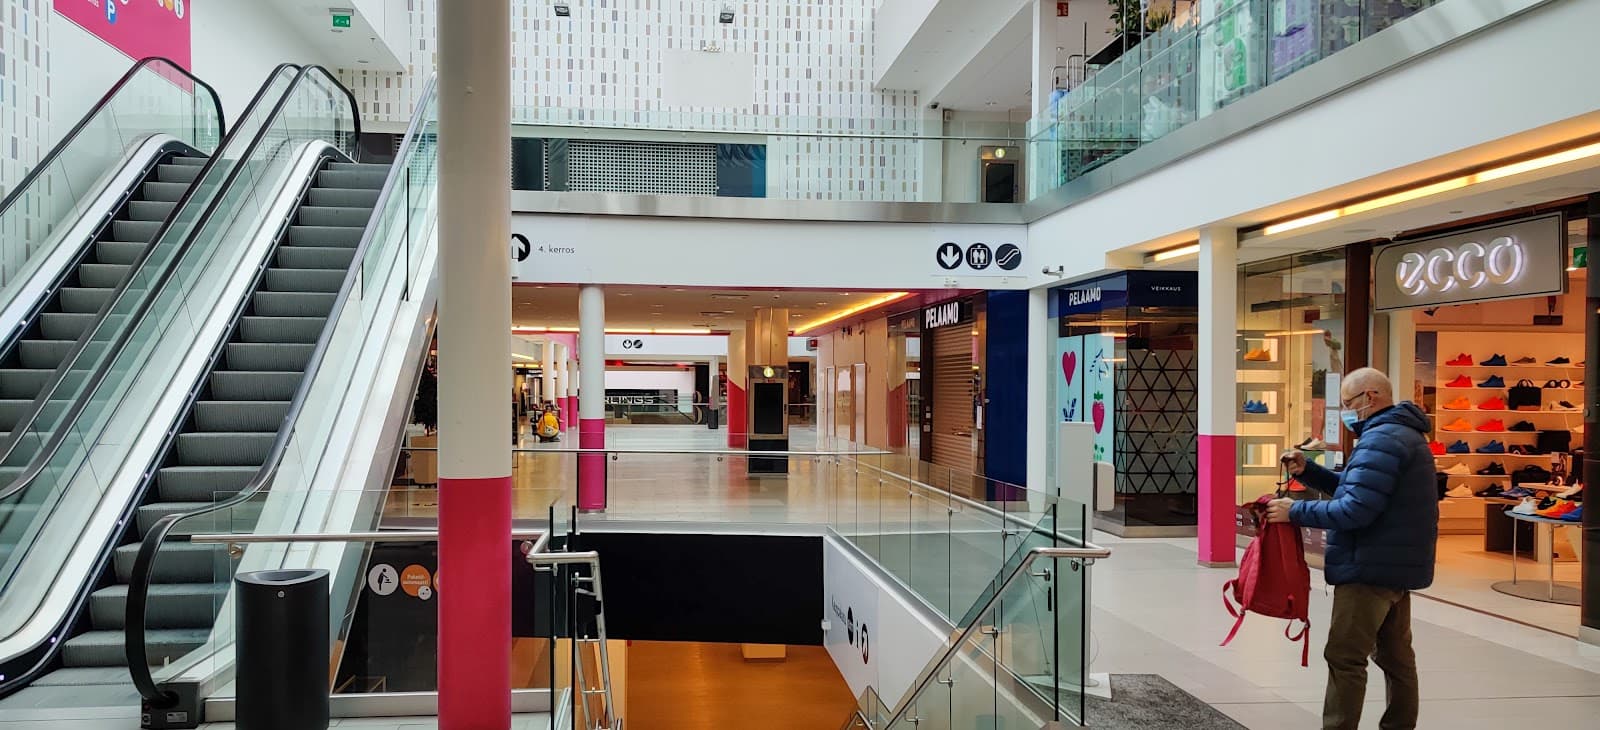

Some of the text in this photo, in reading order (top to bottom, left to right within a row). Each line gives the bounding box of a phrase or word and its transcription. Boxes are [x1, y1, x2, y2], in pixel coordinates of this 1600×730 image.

[549, 244, 575, 254] kerros
[1069, 287, 1101, 306] PELAAMO
[926, 302, 959, 329] PELAAMO
